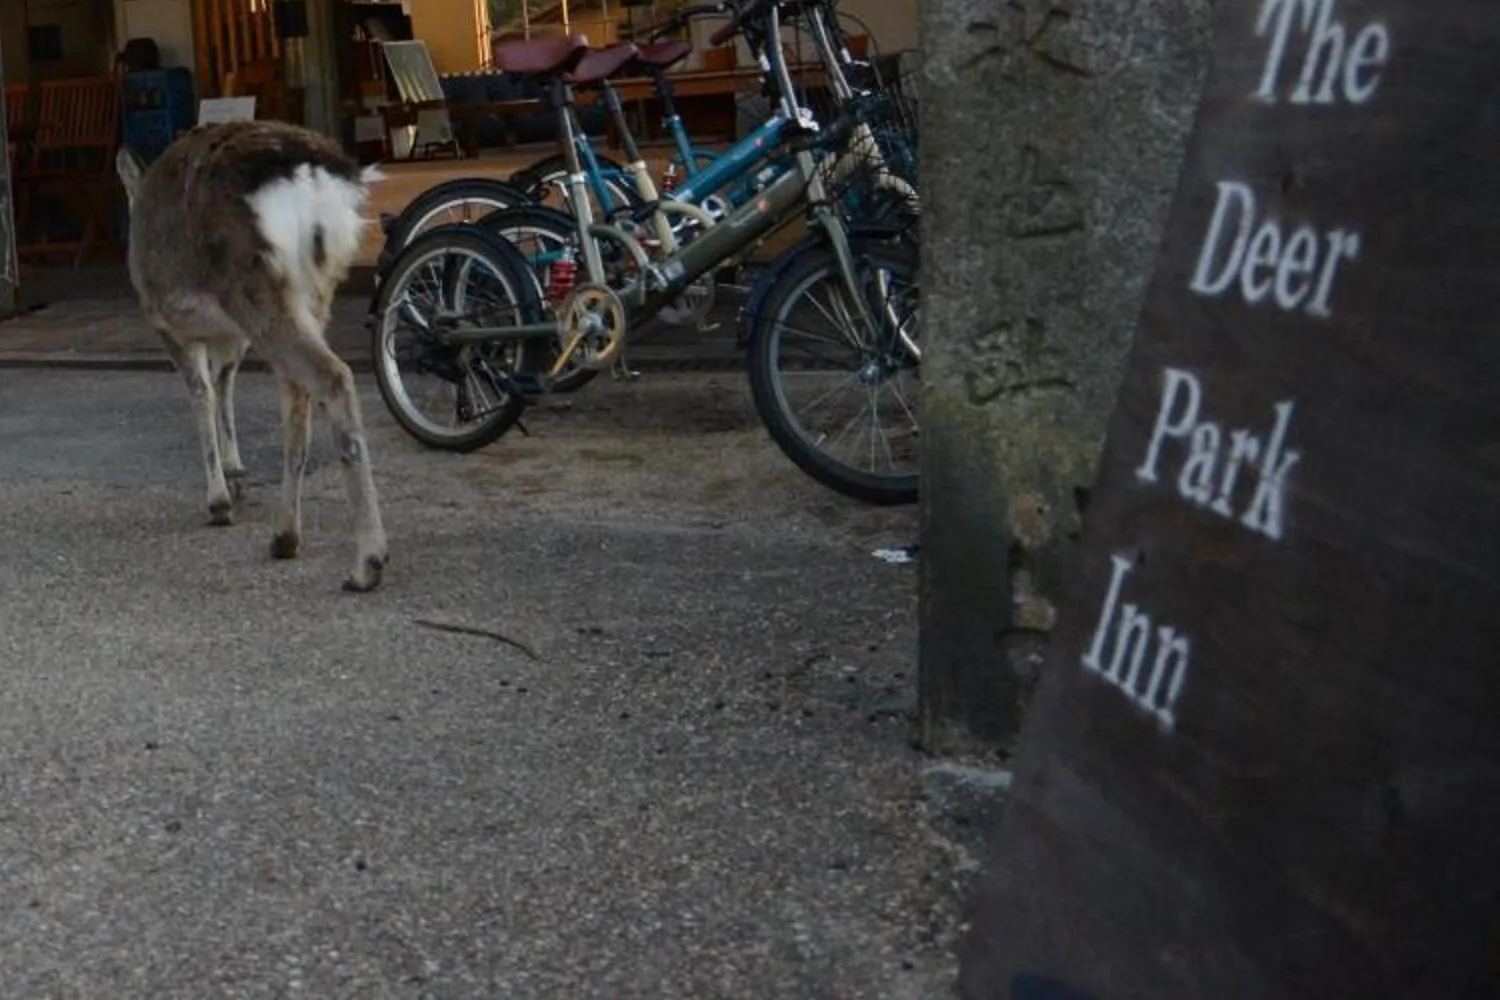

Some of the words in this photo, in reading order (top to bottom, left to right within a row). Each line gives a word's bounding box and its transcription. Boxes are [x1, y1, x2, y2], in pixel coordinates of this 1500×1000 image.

[1189, 181, 1360, 318] Deer
[1135, 367, 1300, 542] Park
[1081, 554, 1190, 732] Inn
